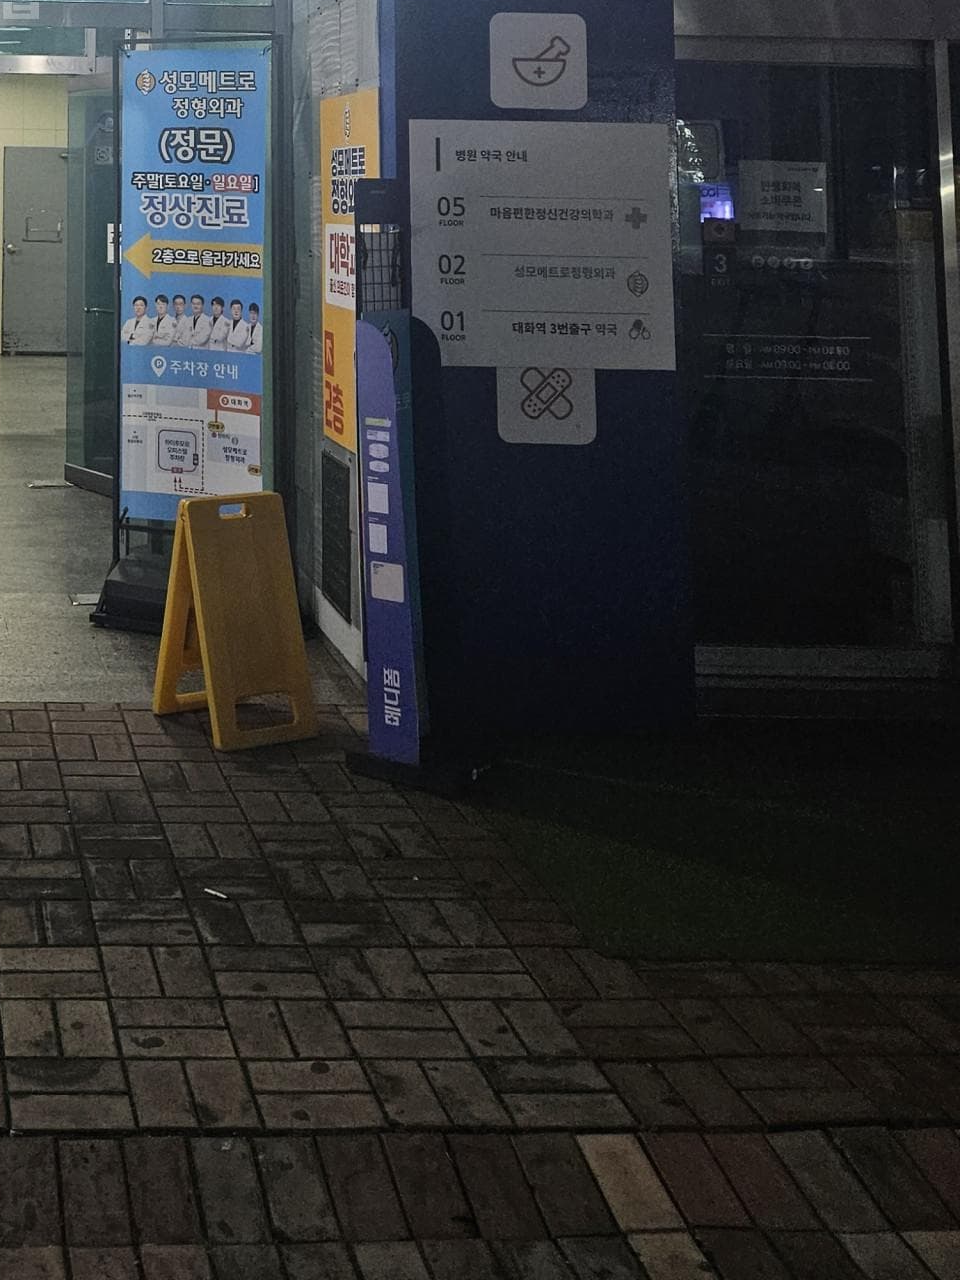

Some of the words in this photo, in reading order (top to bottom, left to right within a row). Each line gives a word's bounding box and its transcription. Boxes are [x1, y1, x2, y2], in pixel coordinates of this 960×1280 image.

[159, 70, 256, 93] 성모메트로
[172, 97, 243, 118] 정형외과
[160, 129, 234, 162] (정문)
[455, 149, 476, 162] 병원
[480, 149, 503, 163] 약국
[506, 149, 528, 163] 안내
[141, 194, 249, 228] 정상진료
[437, 196, 466, 217] 05
[153, 249, 199, 265] 2층으로
[201, 250, 261, 268] 올라가세요
[438, 254, 466, 275] 02
[440, 311, 466, 331] 01
[512, 322, 547, 336] 대화역
[550, 322, 592, 336] 3번출구
[595, 322, 618, 337] 약국
[170, 360, 208, 378] 주차장
[213, 362, 239, 380] 안내
[383, 667, 401, 726] 메디폼
